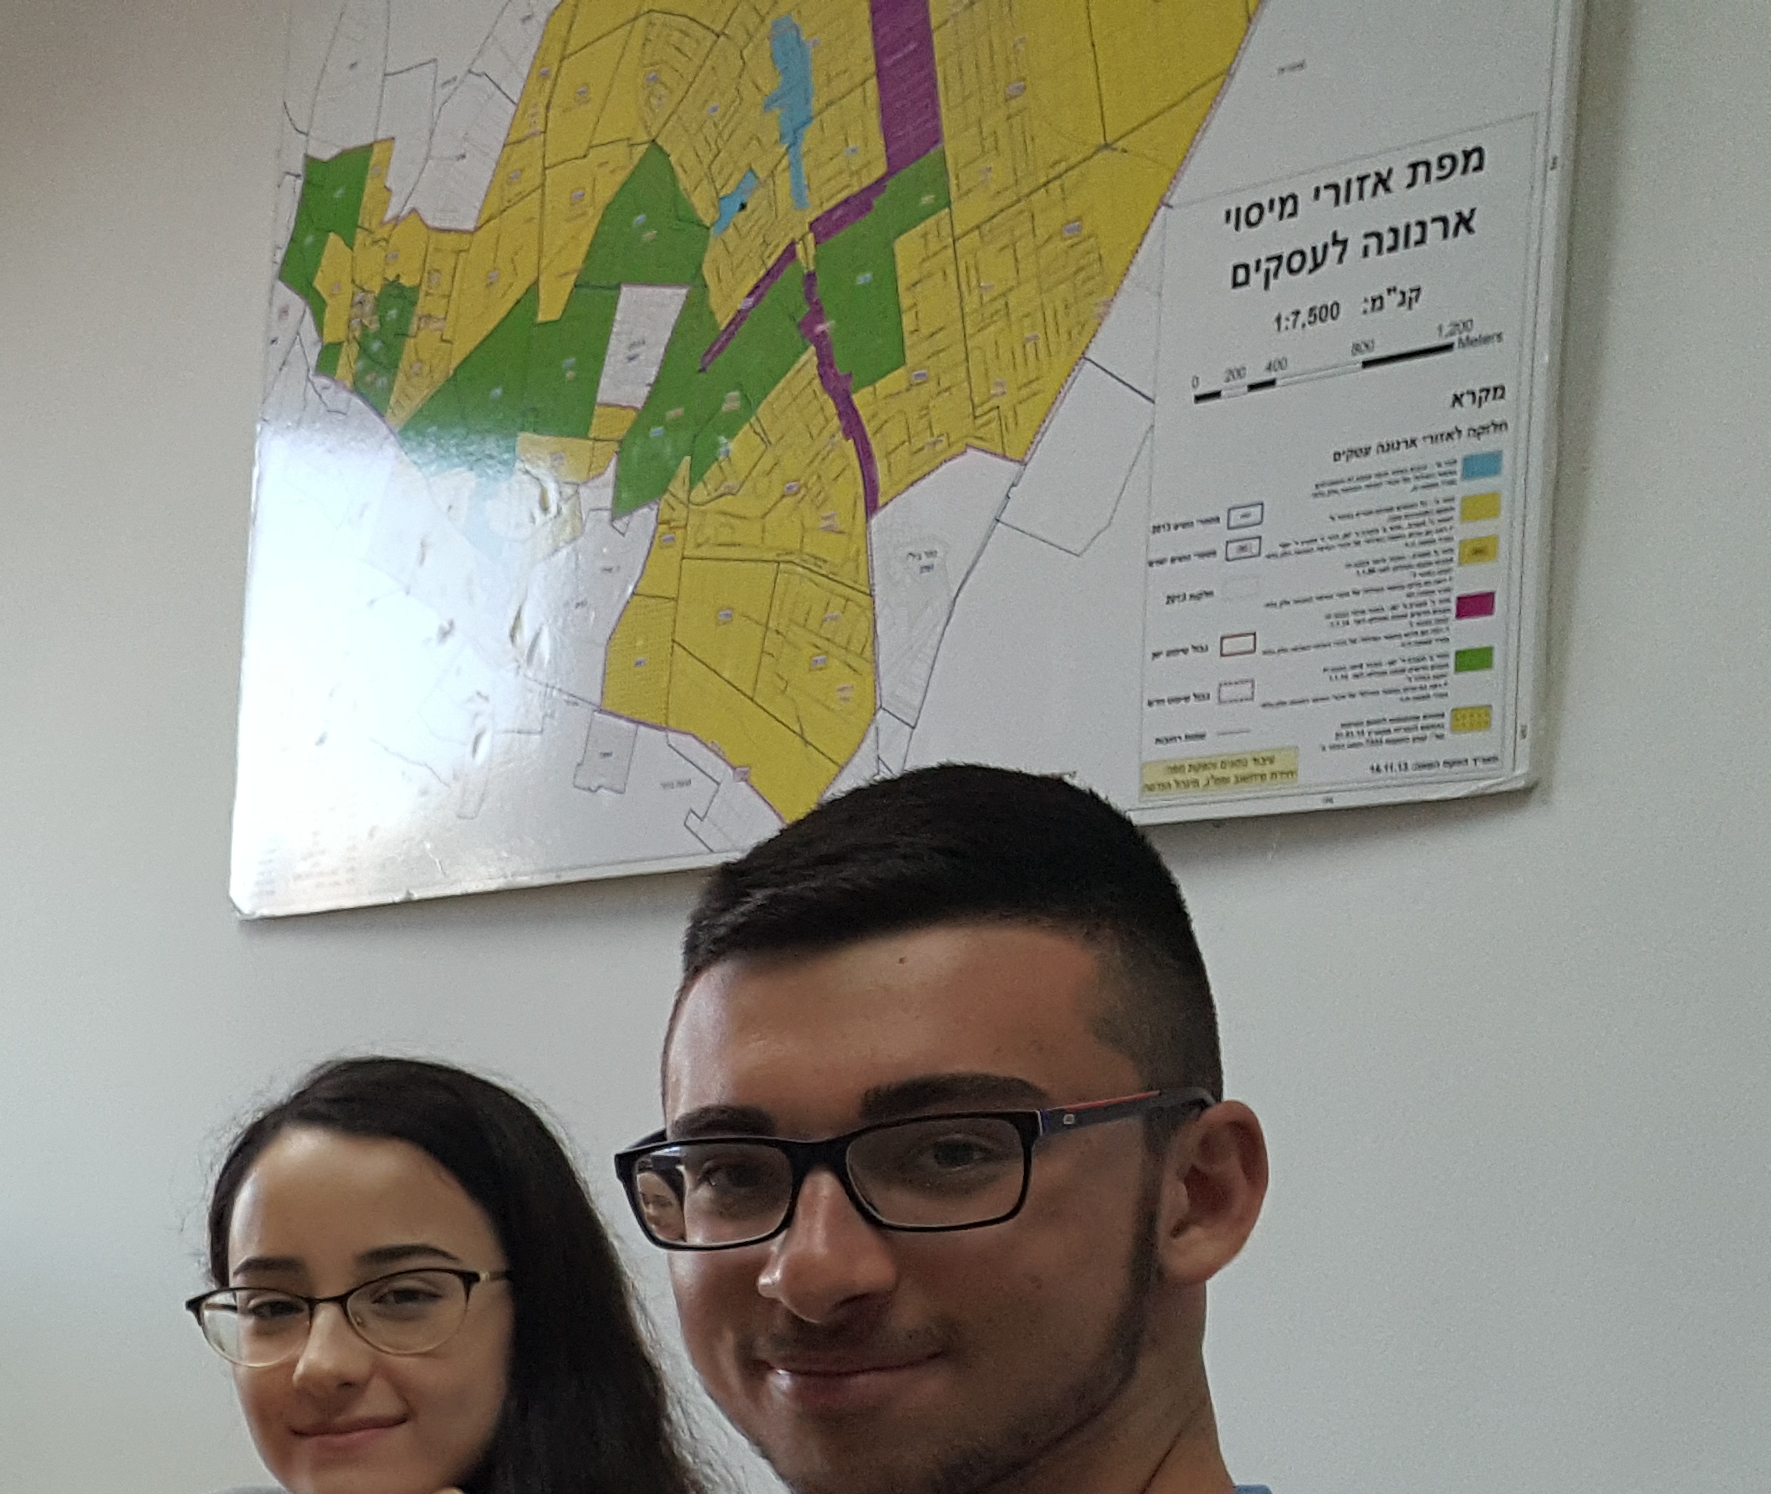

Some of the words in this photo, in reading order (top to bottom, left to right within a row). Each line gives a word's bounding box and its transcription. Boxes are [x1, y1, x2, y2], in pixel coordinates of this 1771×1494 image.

[1313, 167, 1394, 207] אזורי
[1406, 146, 1486, 189] מפת
[1224, 192, 1299, 232] מיסוי
[1361, 207, 1477, 258] ארנונה
[1231, 230, 1349, 291] לעסקים
[1274, 301, 1341, 332] 1:7,500
[1450, 384, 1506, 409] מקרא
